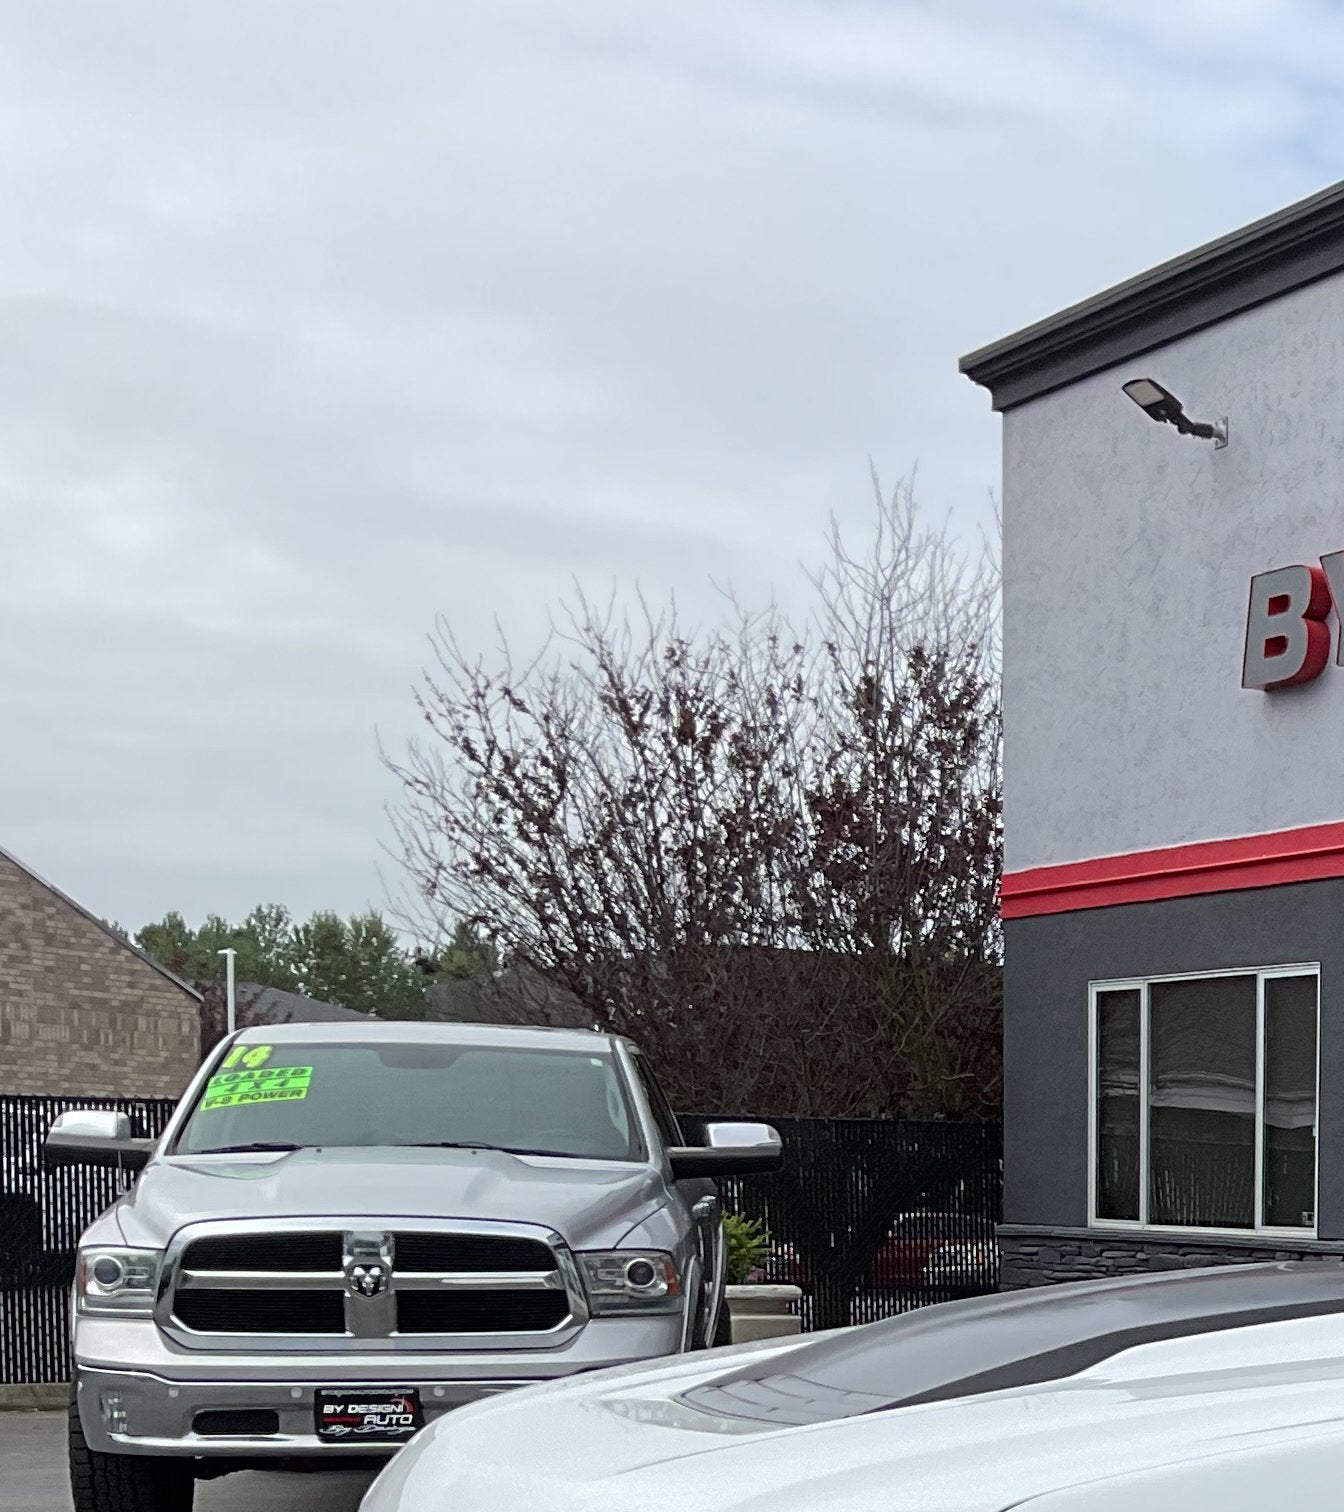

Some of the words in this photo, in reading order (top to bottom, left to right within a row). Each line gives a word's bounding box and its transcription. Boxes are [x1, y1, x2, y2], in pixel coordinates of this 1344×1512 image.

[222, 1045, 273, 1068] 14
[211, 1067, 308, 1085] LOADED
[238, 1088, 303, 1102] POWER
[323, 1404, 344, 1414] BY
[347, 1404, 404, 1414] DESIGN
[364, 1414, 413, 1424] AUTO
